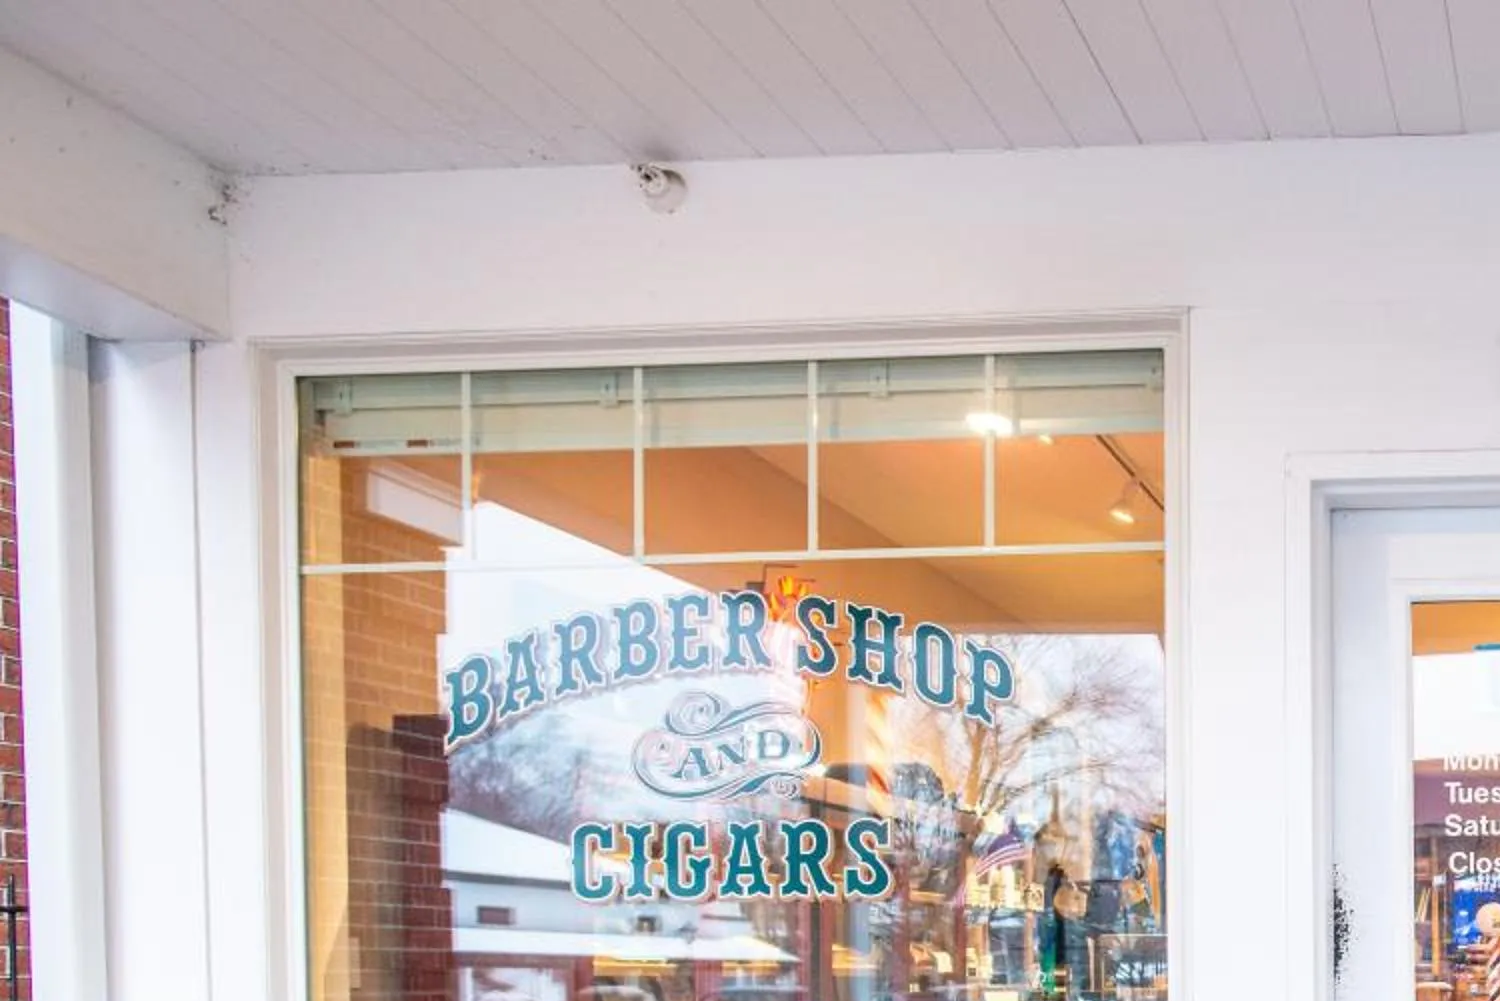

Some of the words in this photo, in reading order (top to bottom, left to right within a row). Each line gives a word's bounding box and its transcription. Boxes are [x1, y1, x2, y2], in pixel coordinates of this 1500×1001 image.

[442, 589, 772, 754] BARBER
[793, 594, 1017, 727] SHOP
[671, 727, 791, 781] AND
[570, 818, 897, 903] CIGARS
